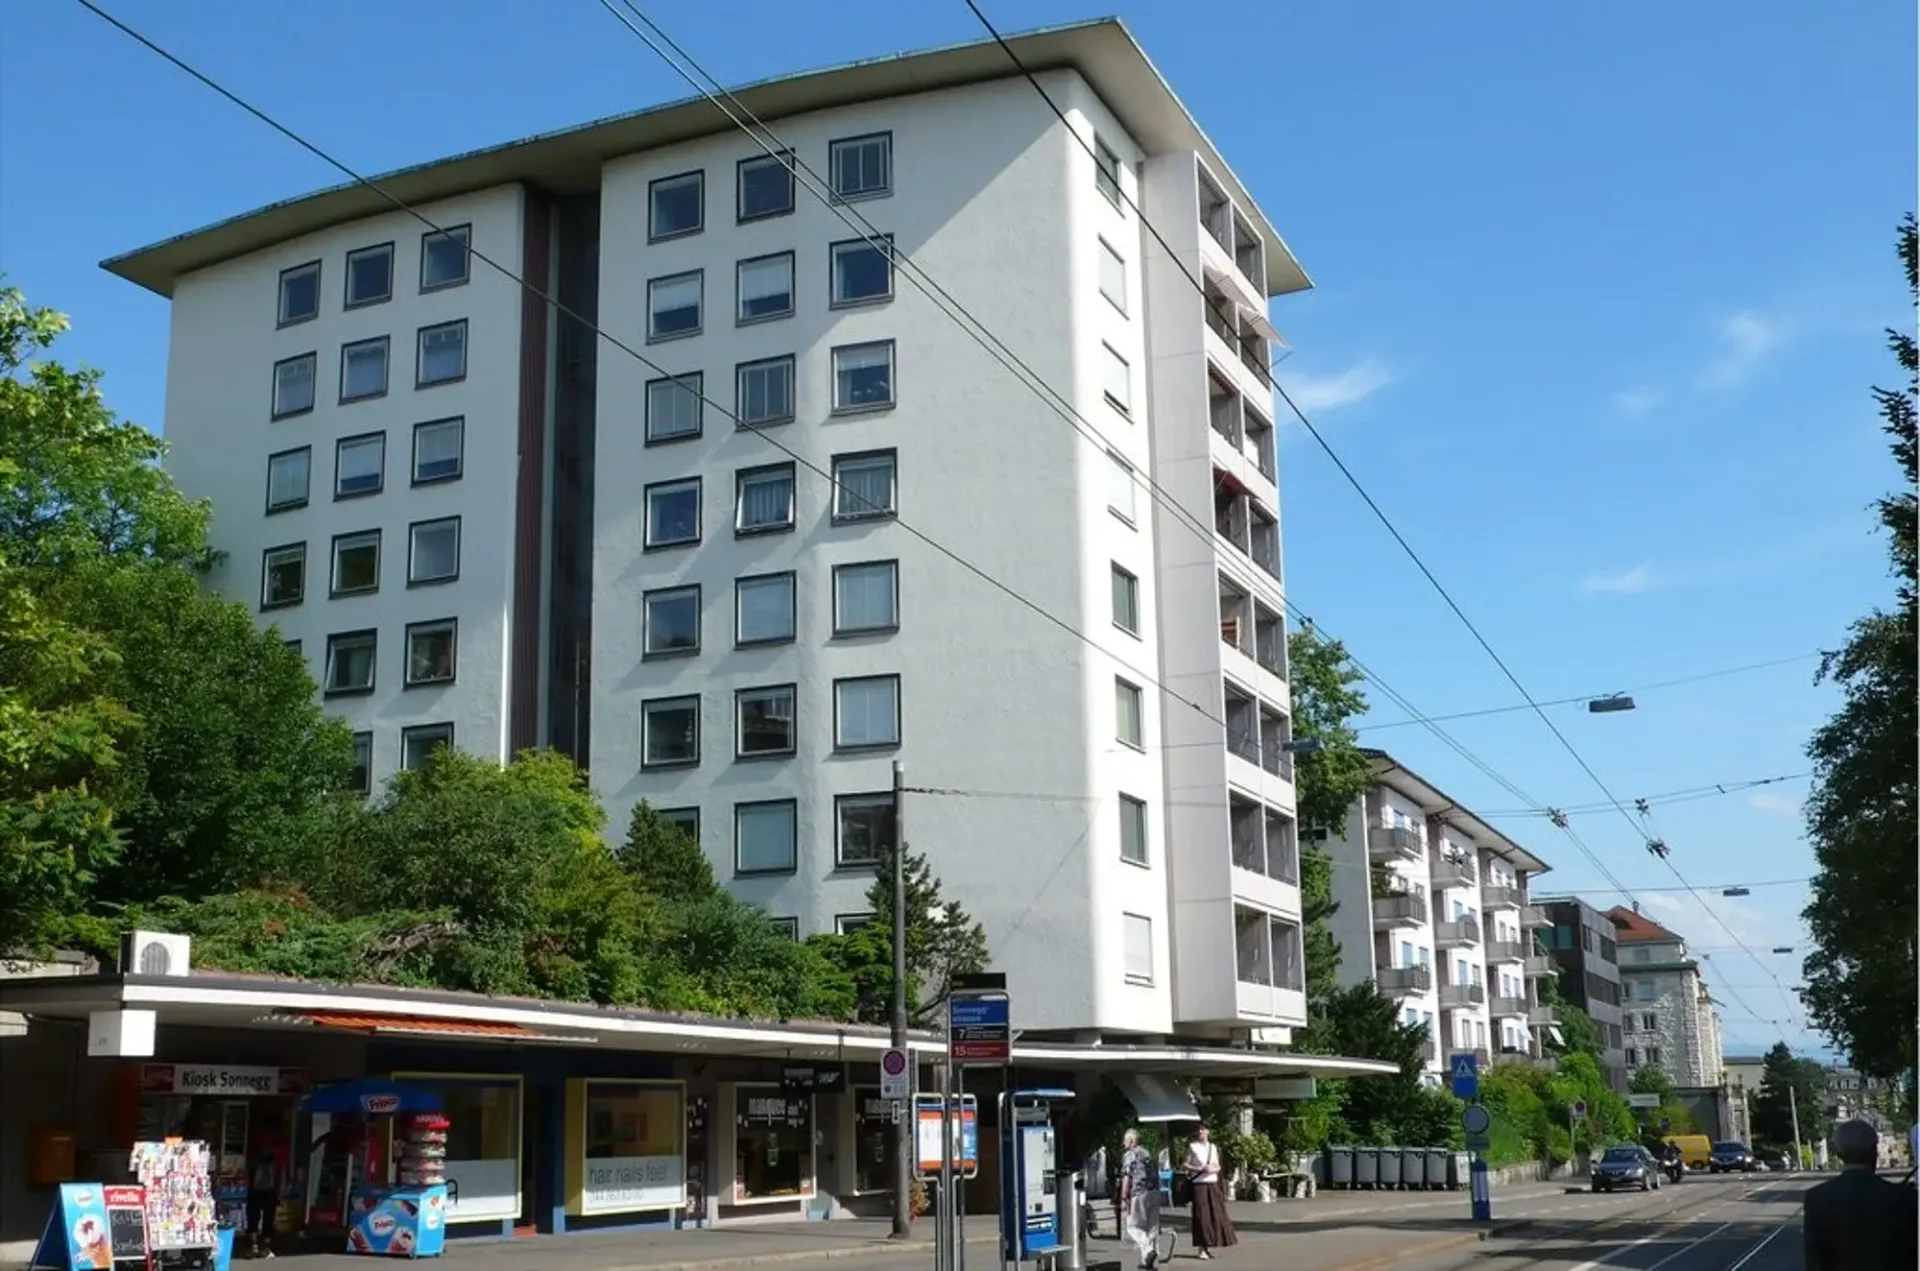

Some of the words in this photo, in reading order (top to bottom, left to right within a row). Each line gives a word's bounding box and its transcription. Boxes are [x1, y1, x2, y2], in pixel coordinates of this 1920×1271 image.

[958, 1029, 965, 1039] 7
[955, 1045, 966, 1056] 15
[182, 1071, 217, 1087] Kiosk
[220, 1072, 271, 1091] Sonnegg
